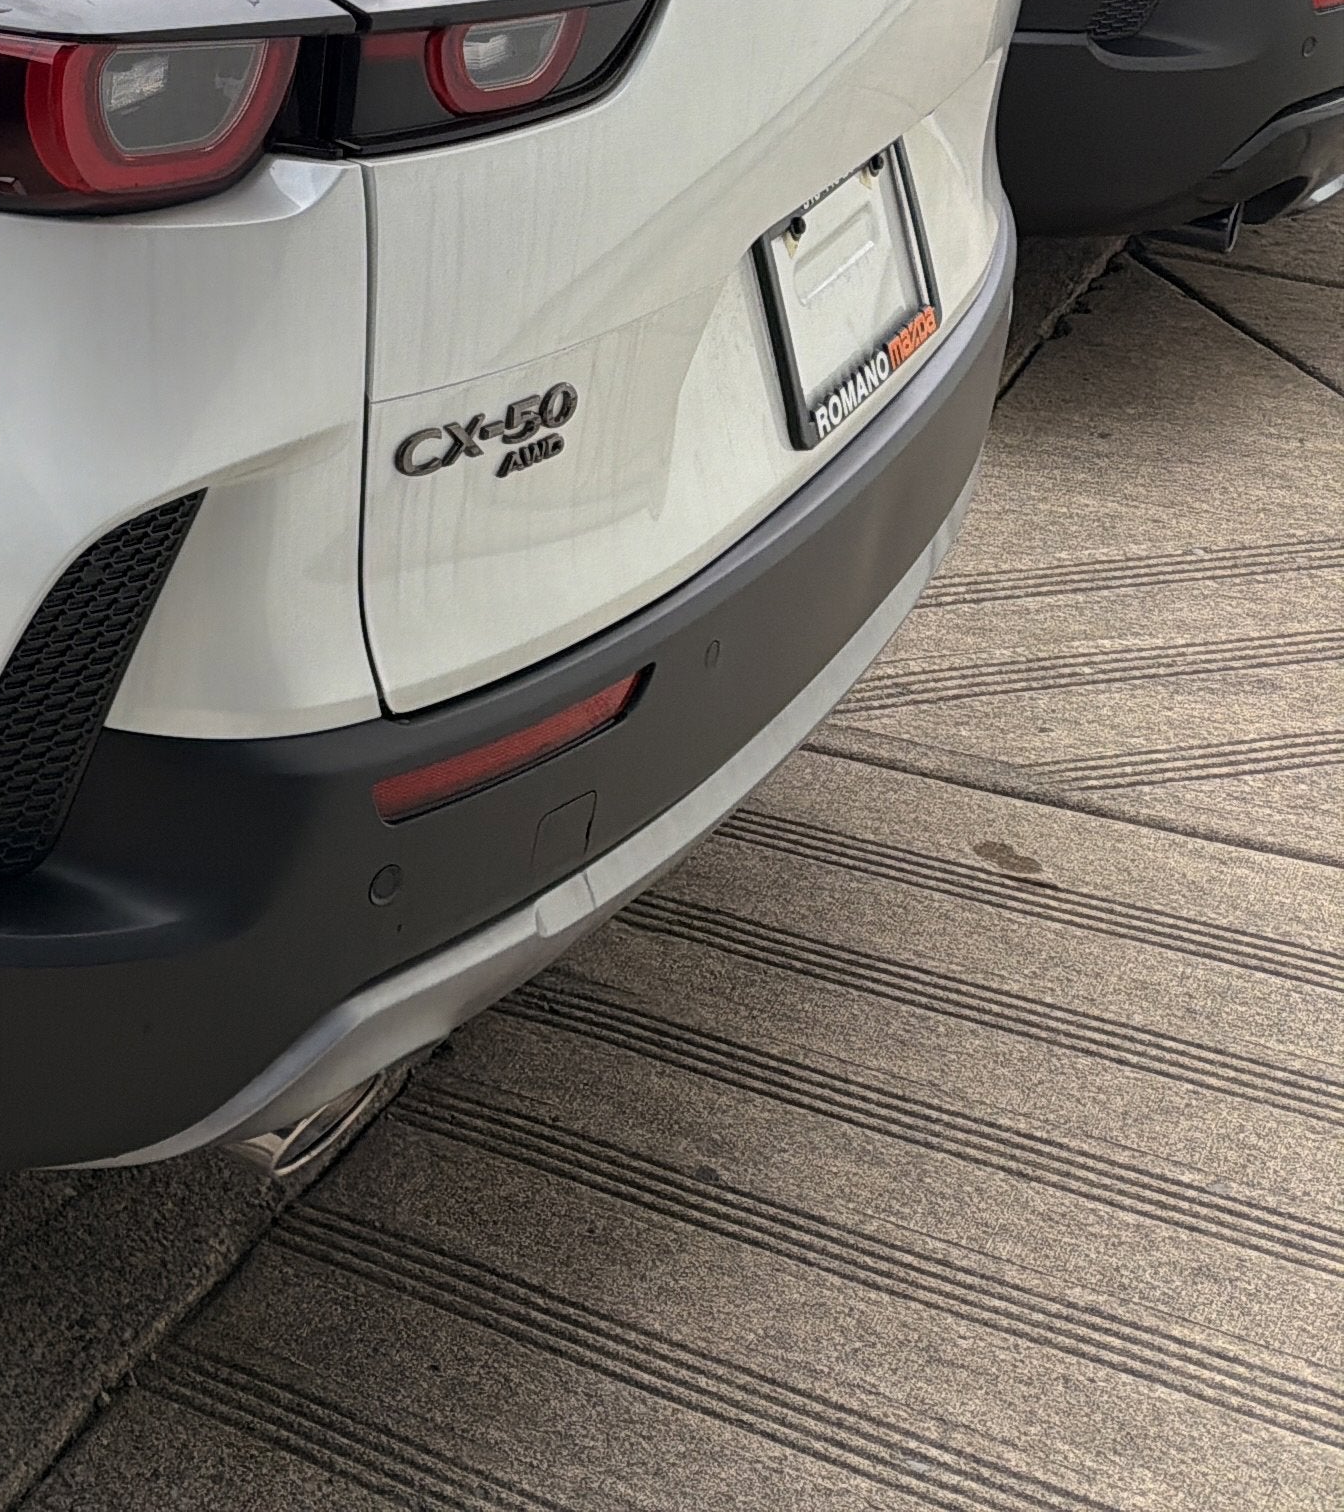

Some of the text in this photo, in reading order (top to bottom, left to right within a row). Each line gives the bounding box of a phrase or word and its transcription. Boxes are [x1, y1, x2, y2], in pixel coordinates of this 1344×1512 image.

[394, 381, 579, 476] CX-50
[815, 350, 890, 438] ROMANO
[495, 433, 566, 478] AWD
